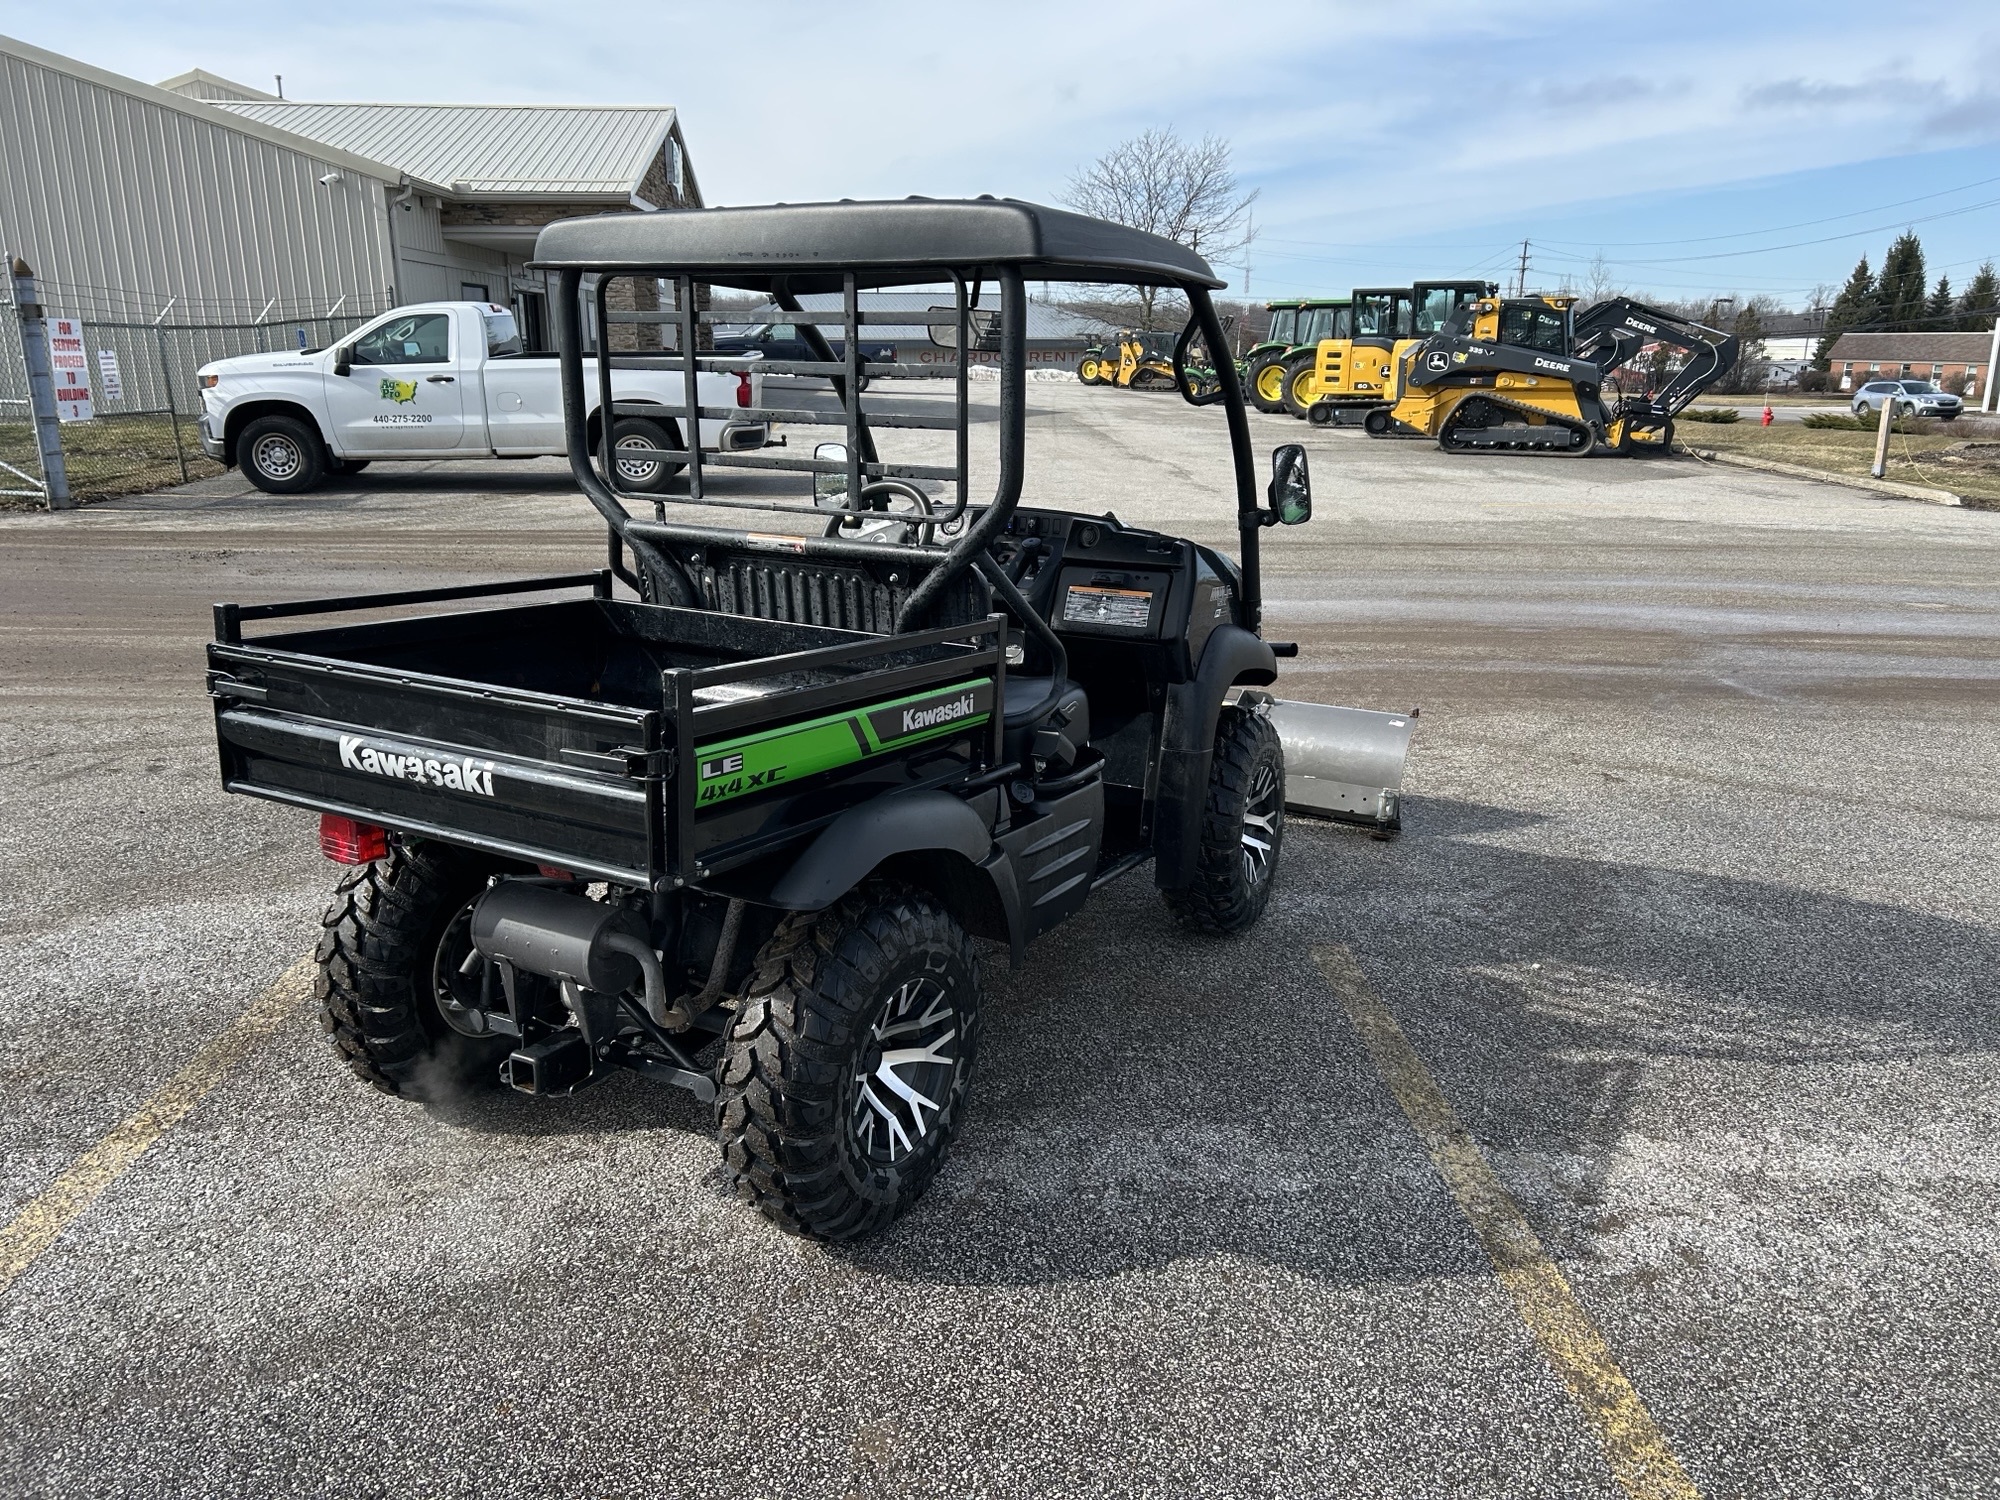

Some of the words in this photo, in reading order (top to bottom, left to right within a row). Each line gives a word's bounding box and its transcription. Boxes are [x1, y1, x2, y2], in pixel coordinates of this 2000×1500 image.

[58, 321, 72, 335] FOR
[1625, 316, 1657, 334] DEERE
[52, 338, 82, 352] SERVICE
[1468, 345, 1484, 355] 335
[53, 354, 84, 368] PROCEED
[920, 351, 1002, 363] CHARDO
[1534, 357, 1571, 372] DEERE
[66, 371, 77, 385] TO
[380, 379, 399, 391] Ag-
[57, 387, 89, 402] BUILDING
[381, 388, 401, 399] Pro
[72, 404, 79, 418] 3
[373, 414, 433, 424] 440-275-2200
[902, 693, 974, 733] Kawasaki
[338, 734, 495, 797] Kawasaki
[702, 753, 743, 780] LE
[700, 777, 743, 802] 4x4
[746, 765, 788, 789] XC
